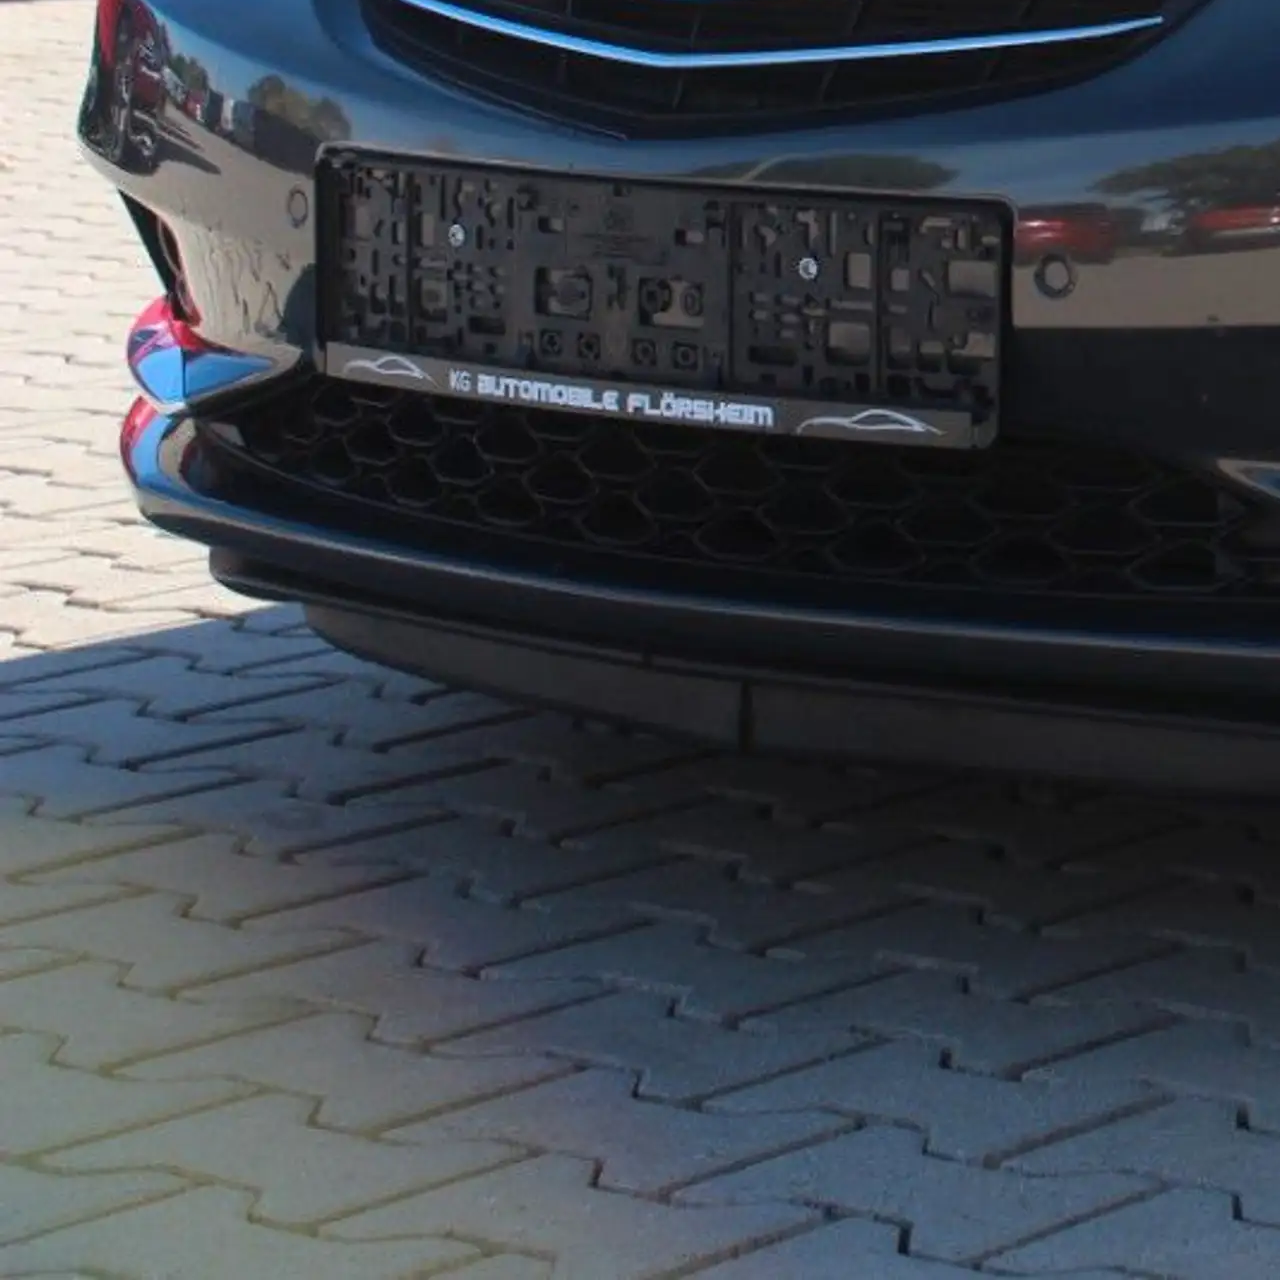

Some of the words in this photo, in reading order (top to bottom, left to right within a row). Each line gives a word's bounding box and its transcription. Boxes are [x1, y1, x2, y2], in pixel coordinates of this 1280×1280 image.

[450, 369, 472, 393] KG
[477, 374, 619, 412] AUTOMOBILE
[626, 391, 774, 427] FLÖRSHEIM
